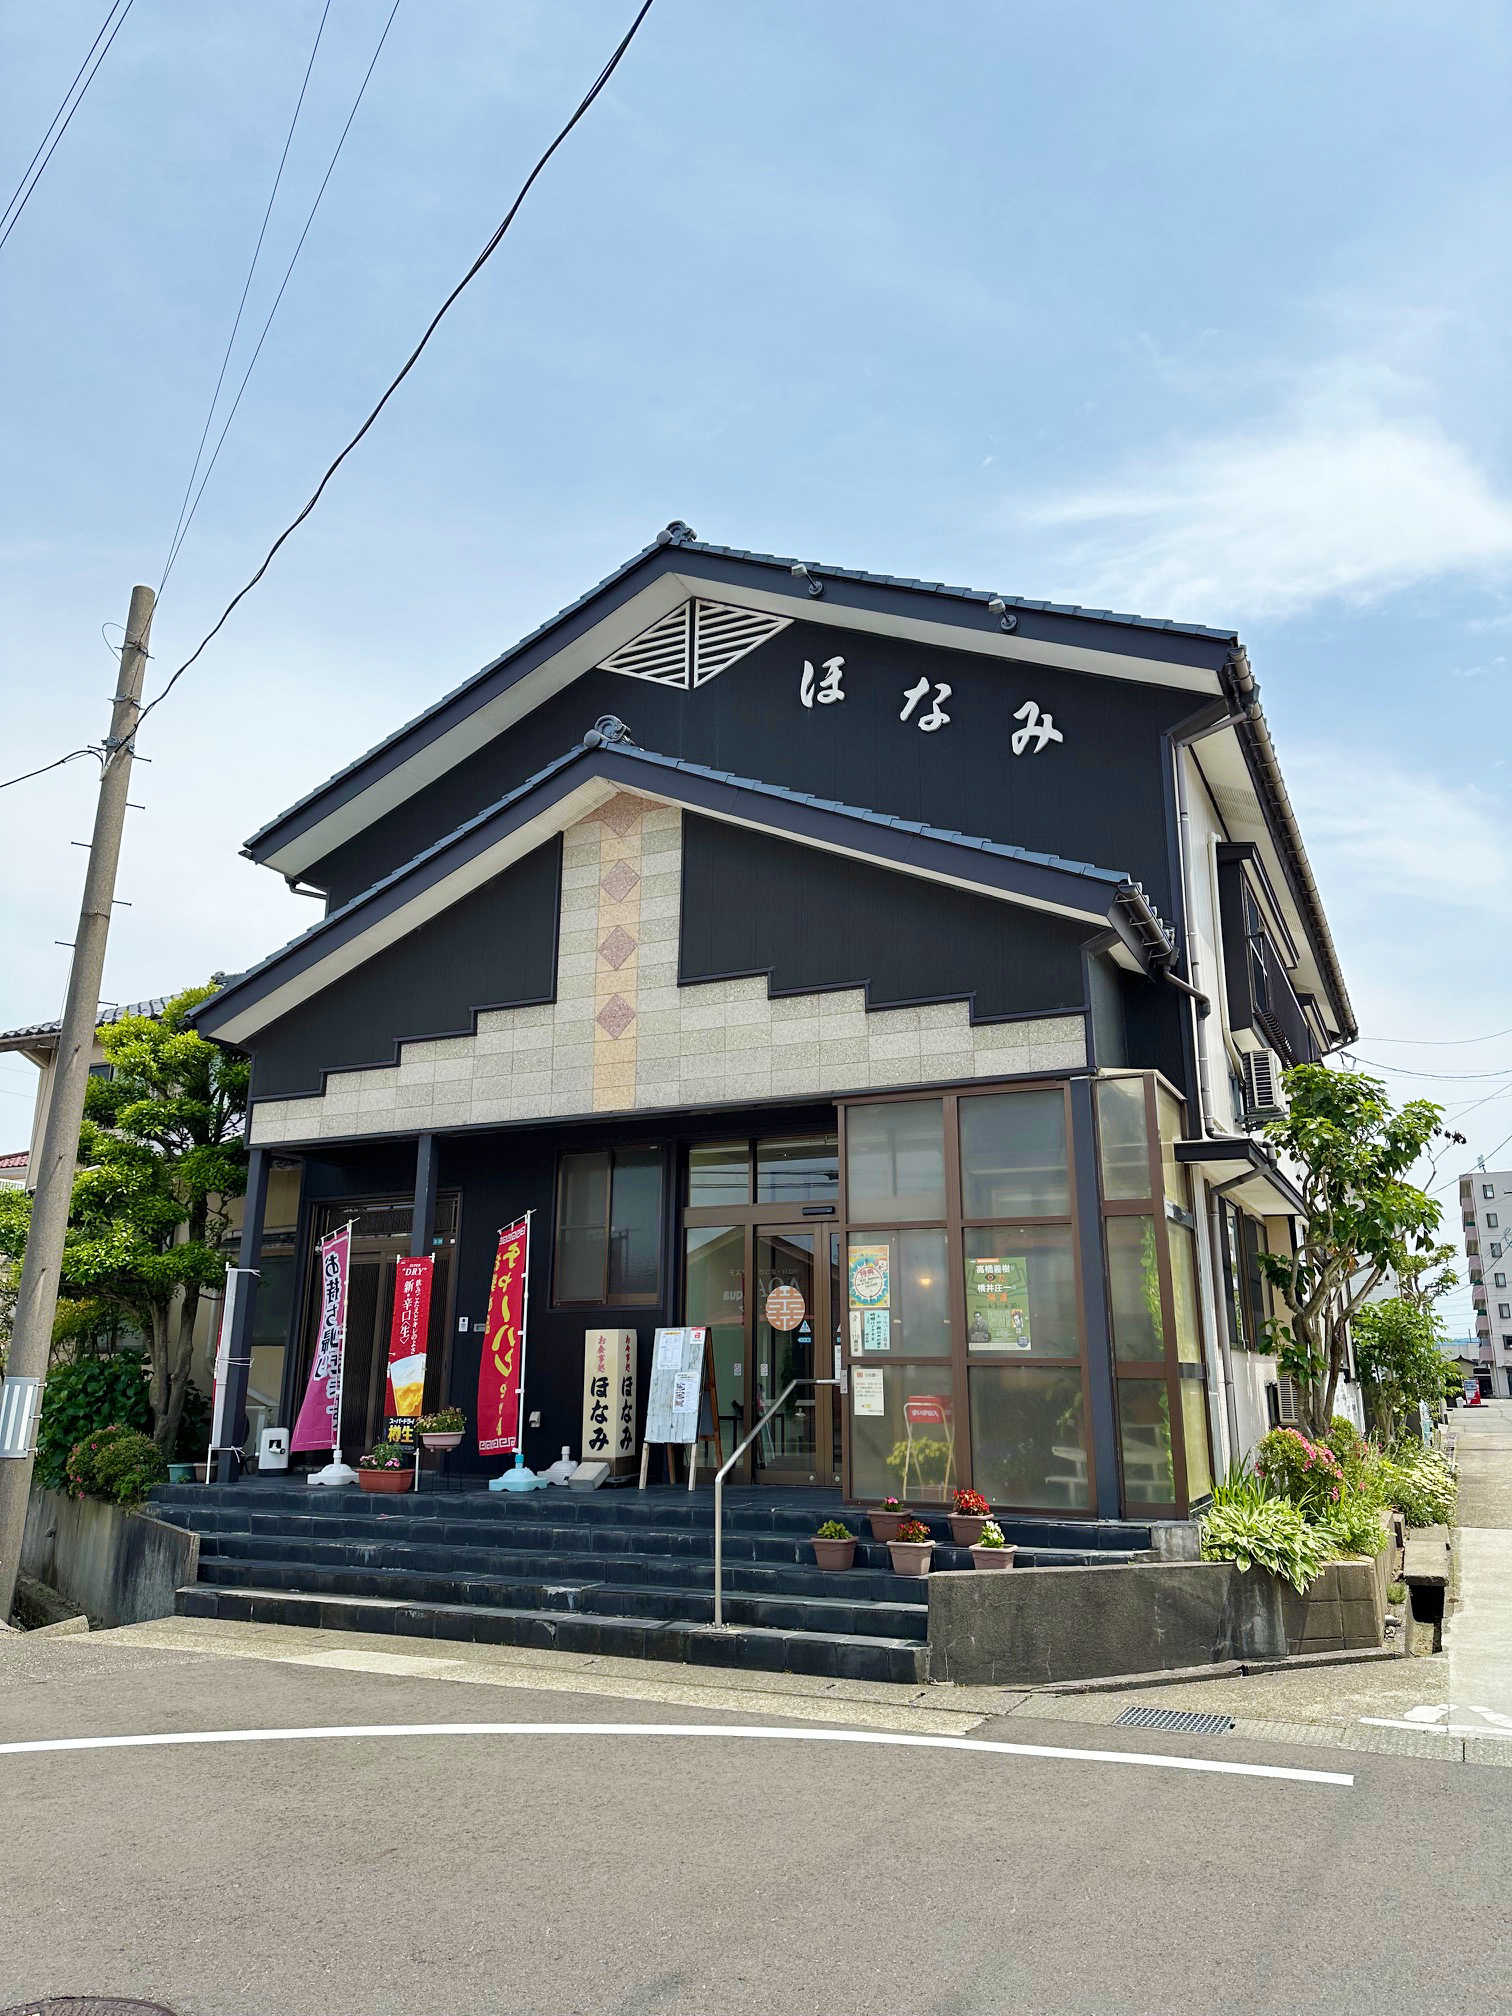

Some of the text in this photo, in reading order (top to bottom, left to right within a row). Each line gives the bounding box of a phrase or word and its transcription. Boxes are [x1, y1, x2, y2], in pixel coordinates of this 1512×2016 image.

[800, 656, 1064, 756] ほなみ
[597, 1335, 606, 1373] お食事処
[387, 1424, 414, 1443] 樽生
[589, 1376, 610, 1451] ほなみ
[620, 1376, 633, 1451] ほなみ
